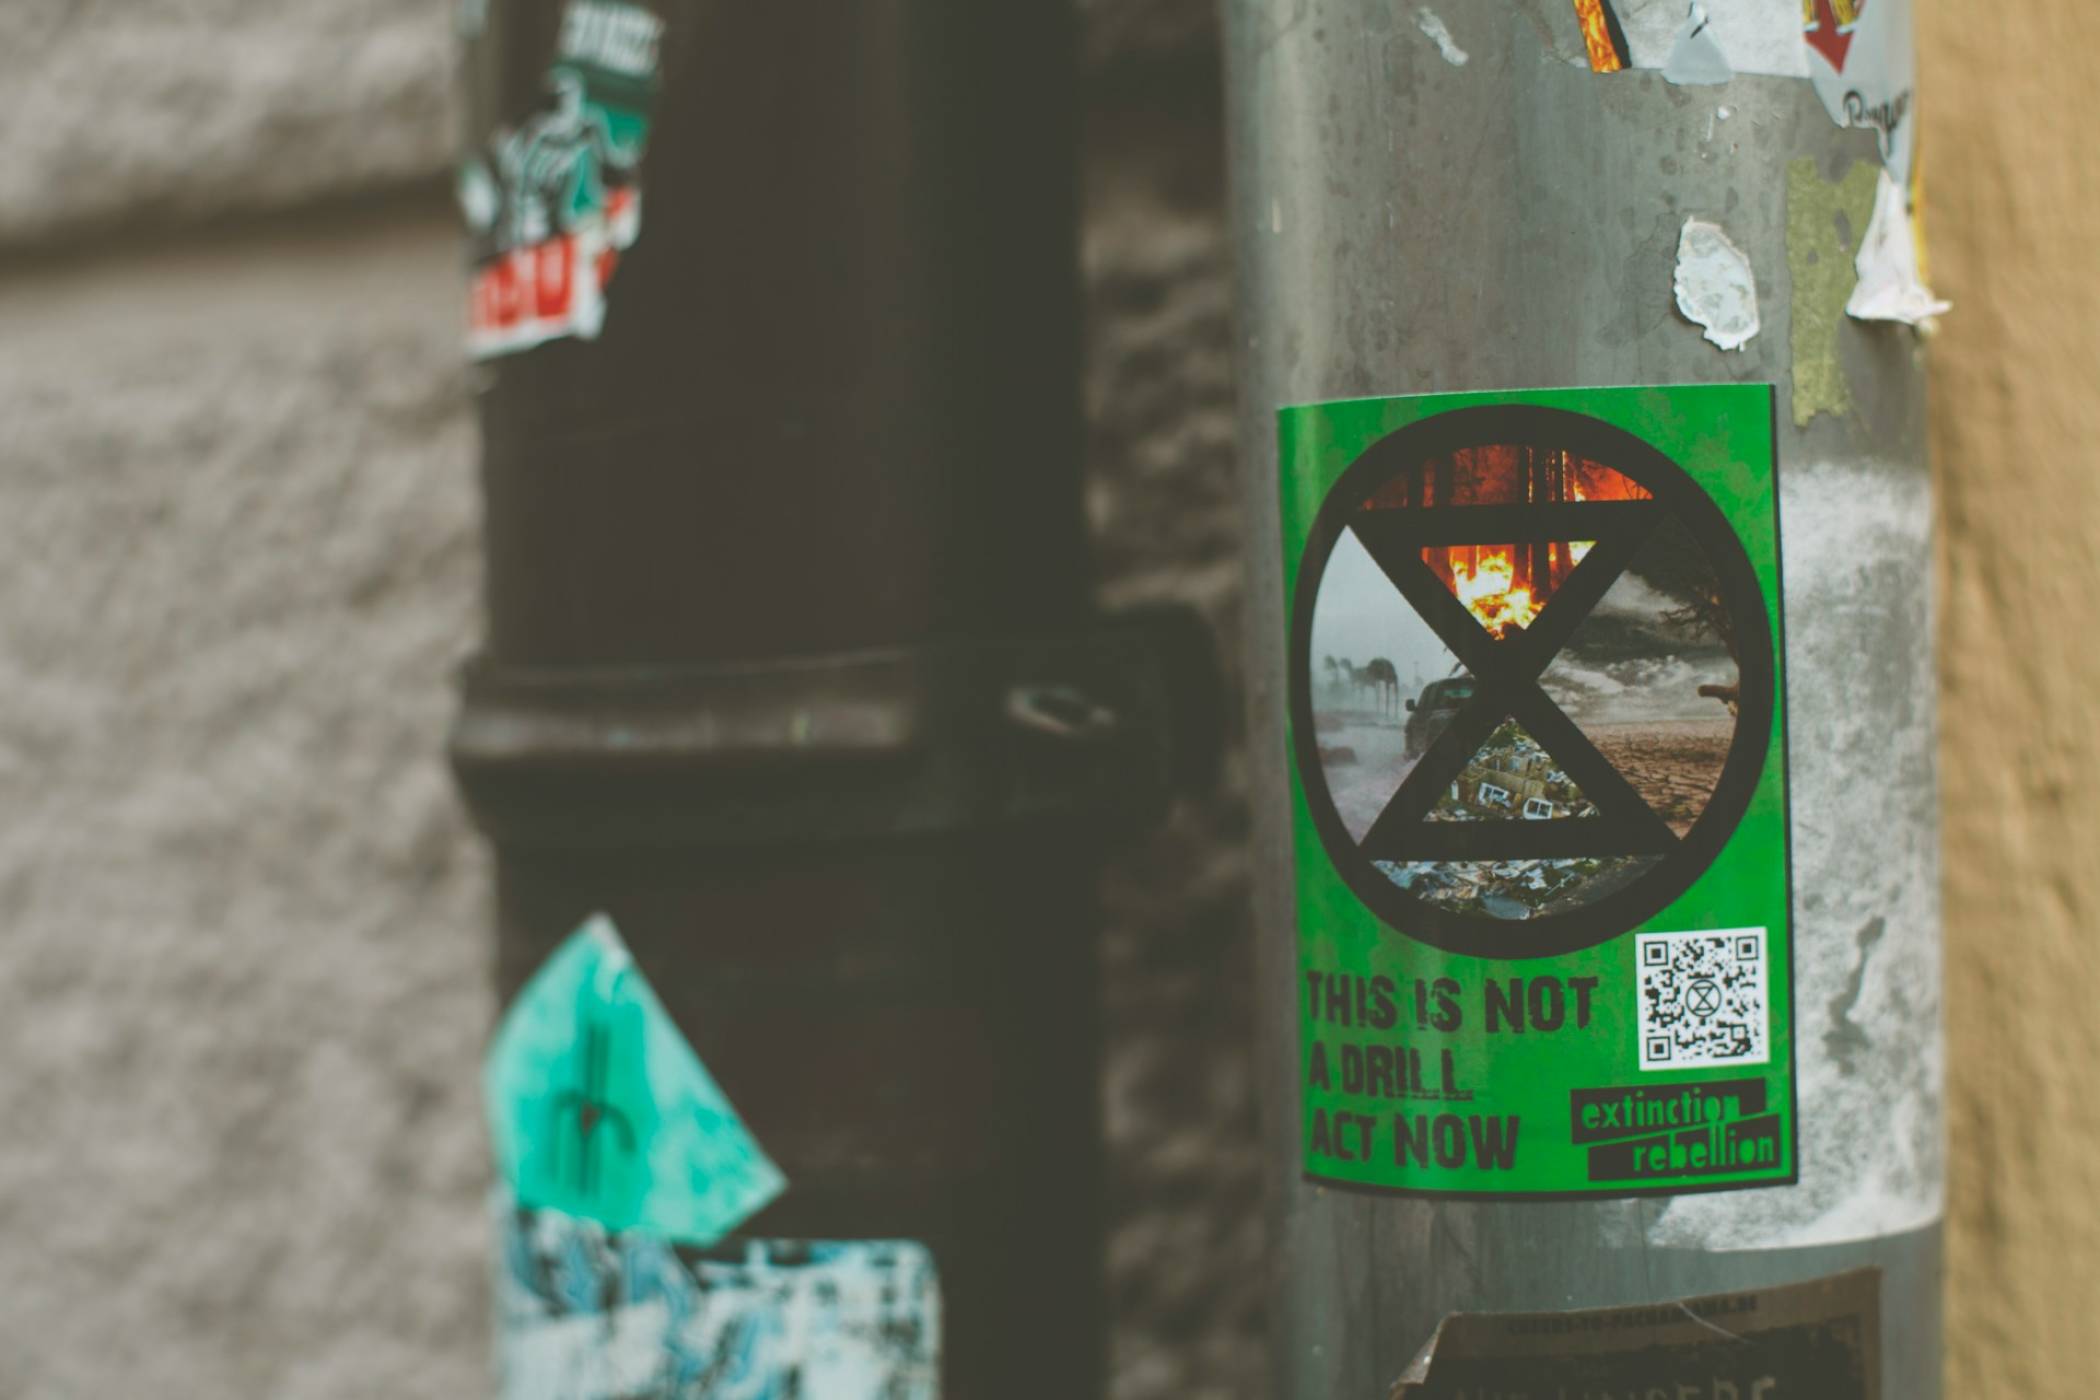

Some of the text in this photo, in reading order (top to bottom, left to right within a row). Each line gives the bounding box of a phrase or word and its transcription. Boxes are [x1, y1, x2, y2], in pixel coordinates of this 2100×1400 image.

[1306, 970, 1599, 1034] THIS IS NOT
[1308, 1040, 1475, 1102] A DRILL
[1310, 1107, 1521, 1171] ACT NOW
[1581, 1087, 1740, 1129] extinction
[1632, 1124, 1775, 1172] rebellion
